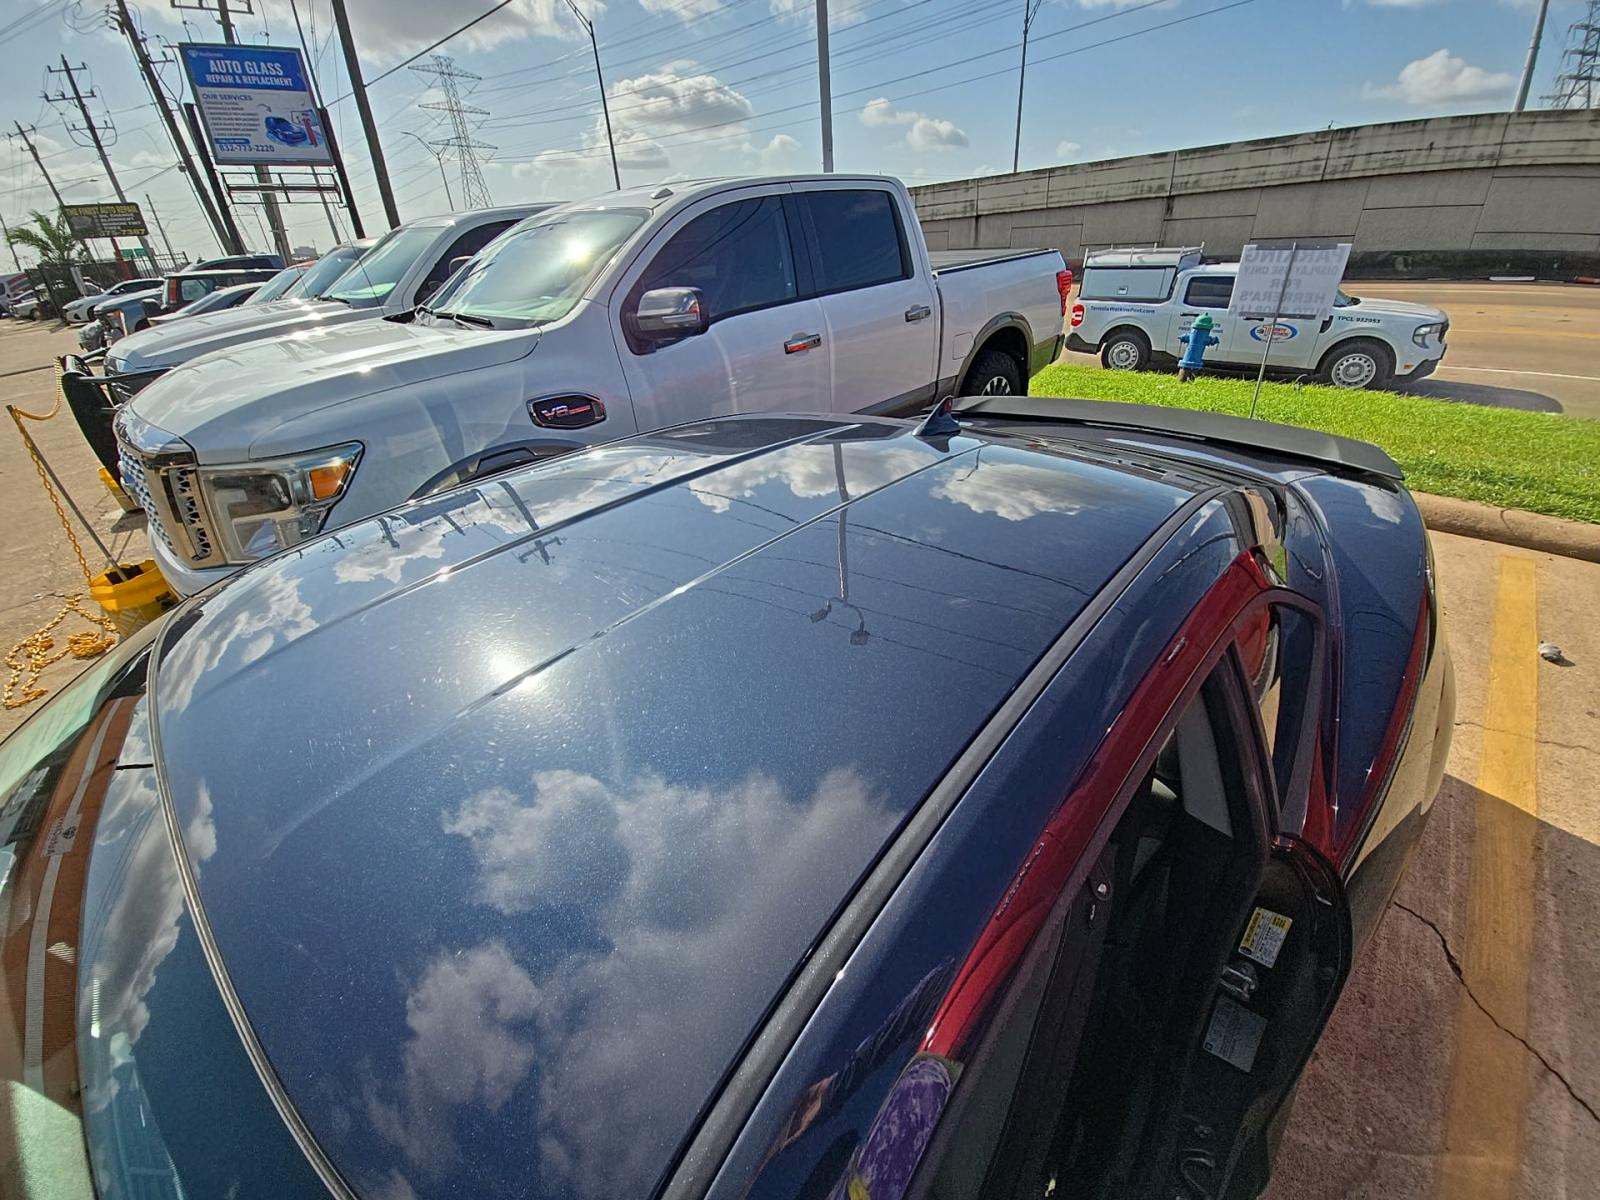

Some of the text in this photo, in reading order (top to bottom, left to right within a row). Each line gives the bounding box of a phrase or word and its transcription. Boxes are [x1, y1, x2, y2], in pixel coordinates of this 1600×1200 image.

[209, 60, 284, 76] AUTO GLASS
[205, 74, 293, 87] REPAIR & REPLACEMENT
[220, 93, 254, 101] SERVICES
